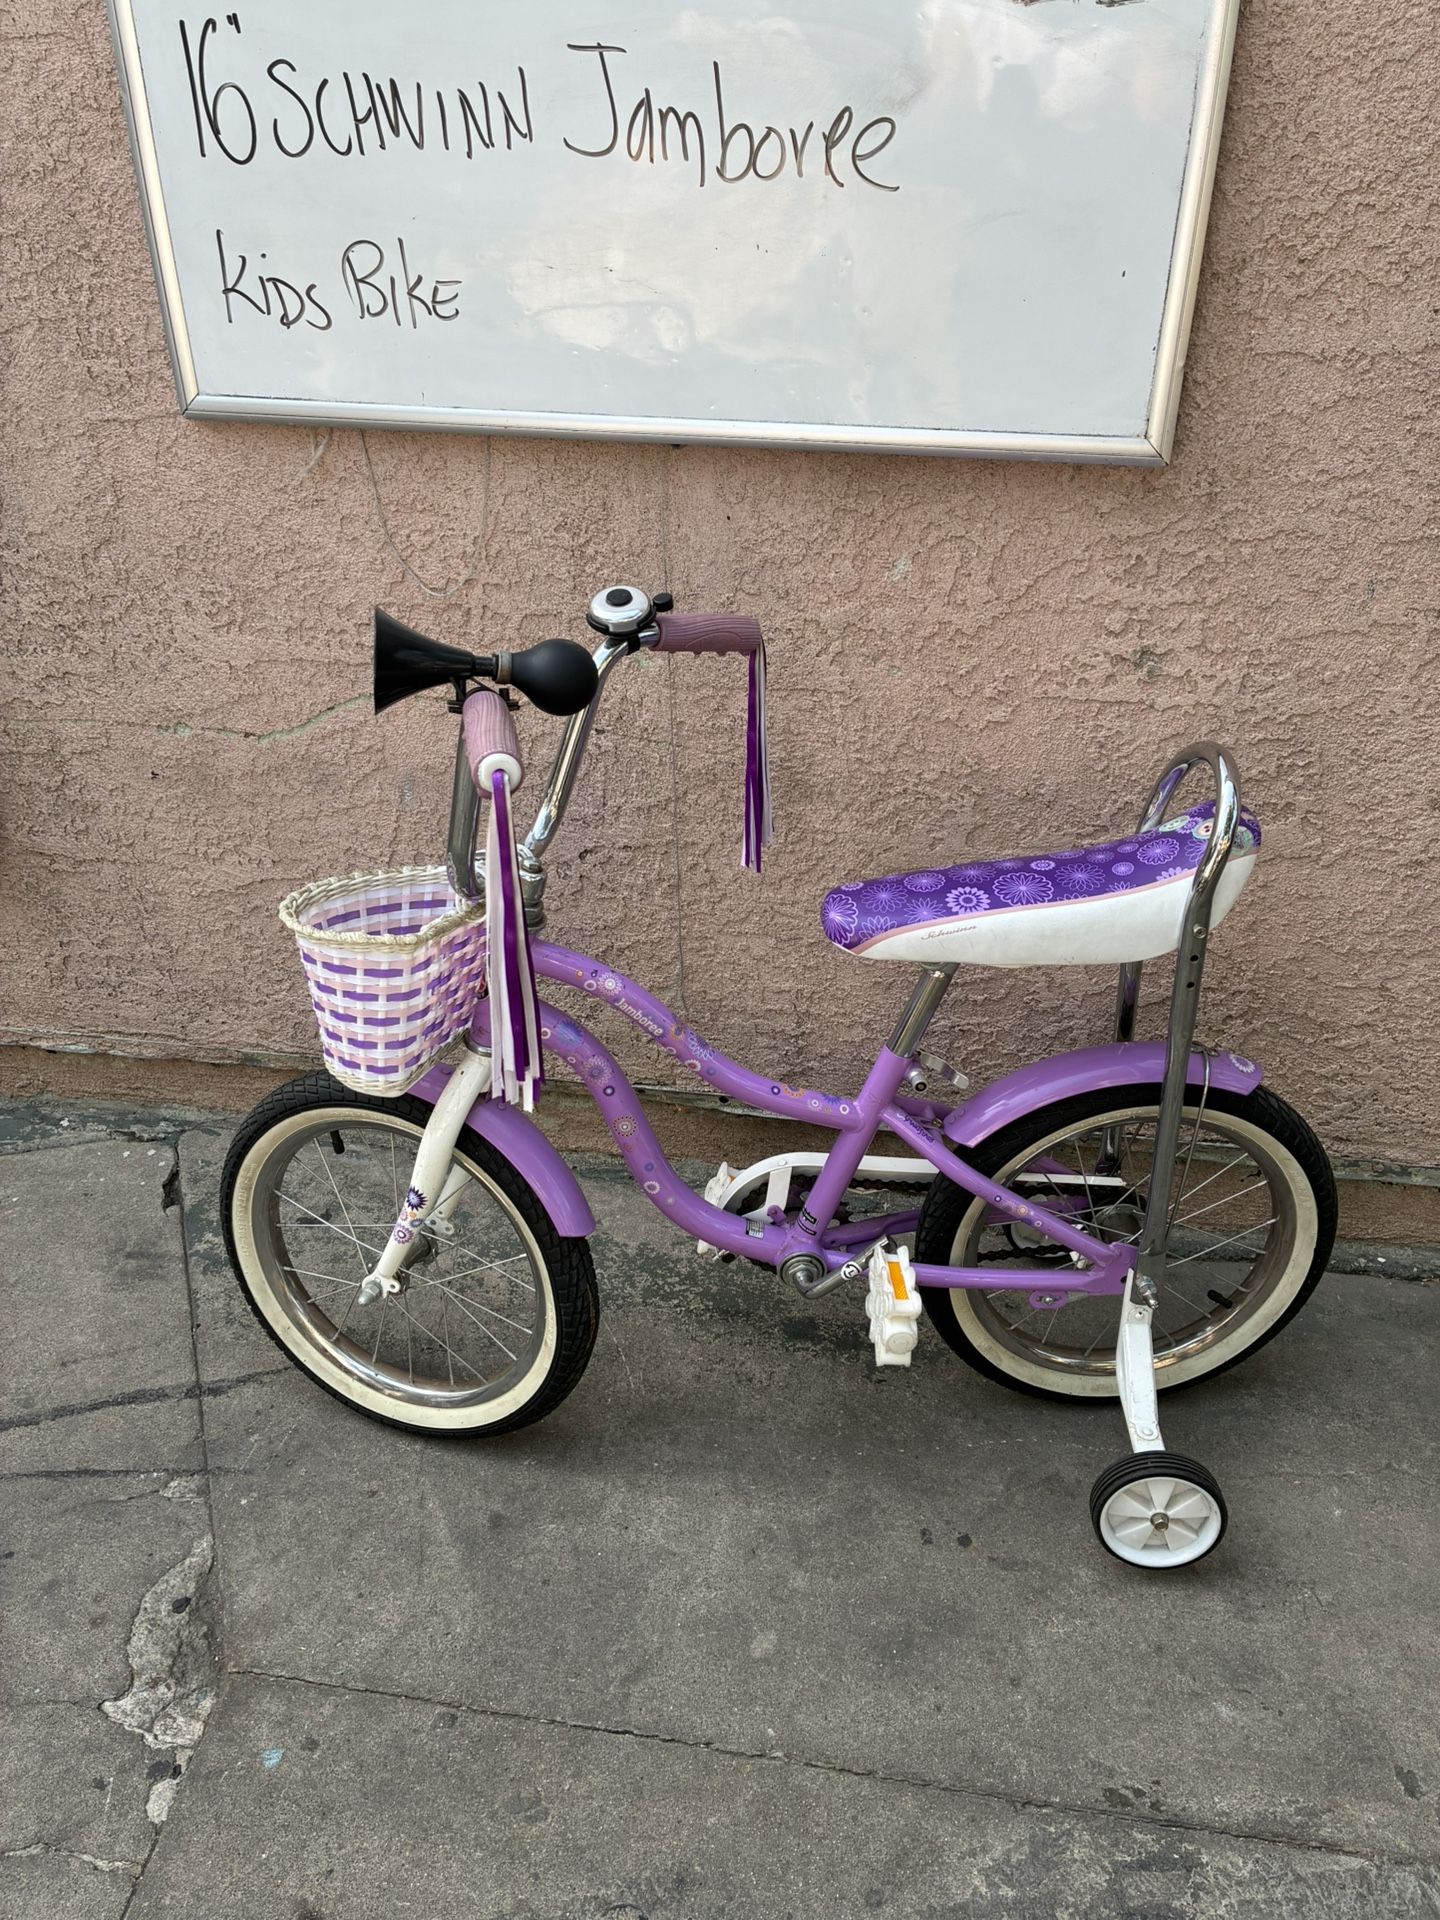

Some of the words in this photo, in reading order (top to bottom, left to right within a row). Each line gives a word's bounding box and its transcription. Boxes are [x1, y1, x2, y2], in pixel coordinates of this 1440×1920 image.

[266, 58, 534, 160] SCHWINN
[563, 41, 900, 193] Jamboree
[614, 997, 663, 1036] Jamboree
